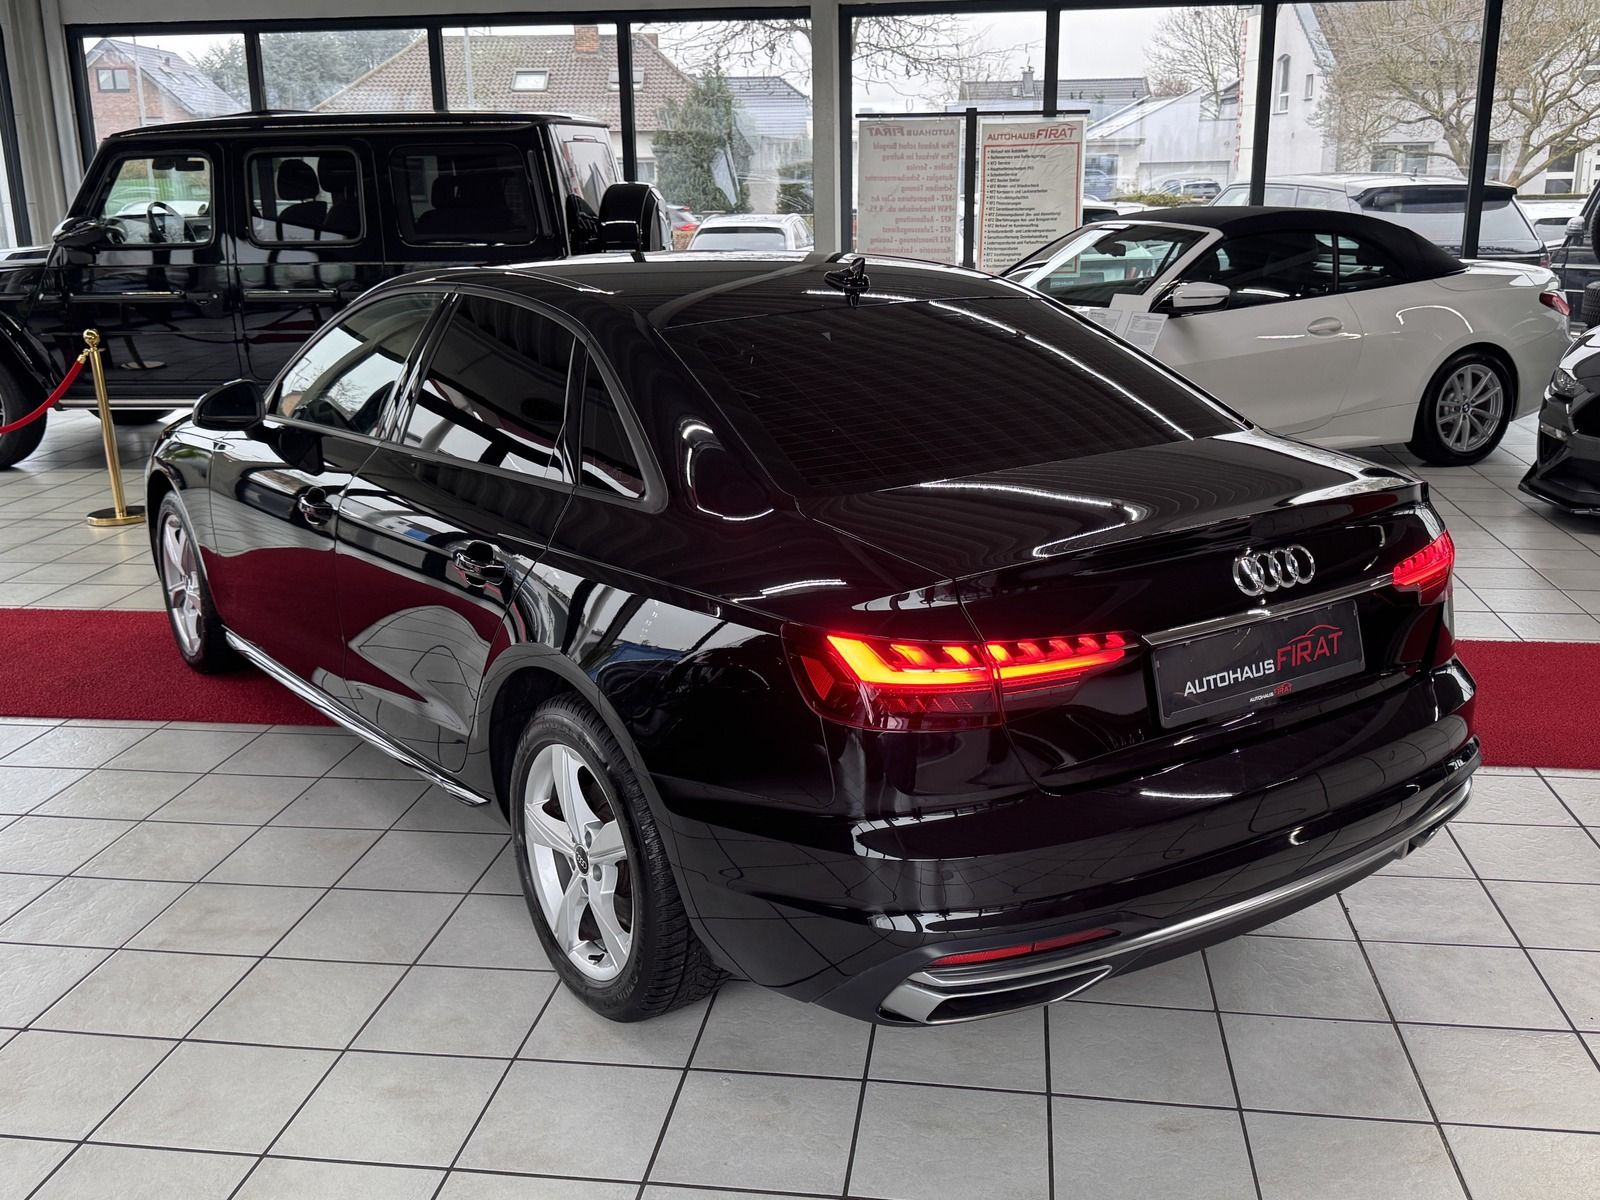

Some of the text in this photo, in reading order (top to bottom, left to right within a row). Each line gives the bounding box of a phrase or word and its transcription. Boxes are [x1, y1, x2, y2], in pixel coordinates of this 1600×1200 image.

[1036, 128, 1077, 139] FIRAT
[1184, 631, 1343, 697] AUTOHAUS FIRAT
[1250, 684, 1294, 702] AUTOHAUS FIRAT
